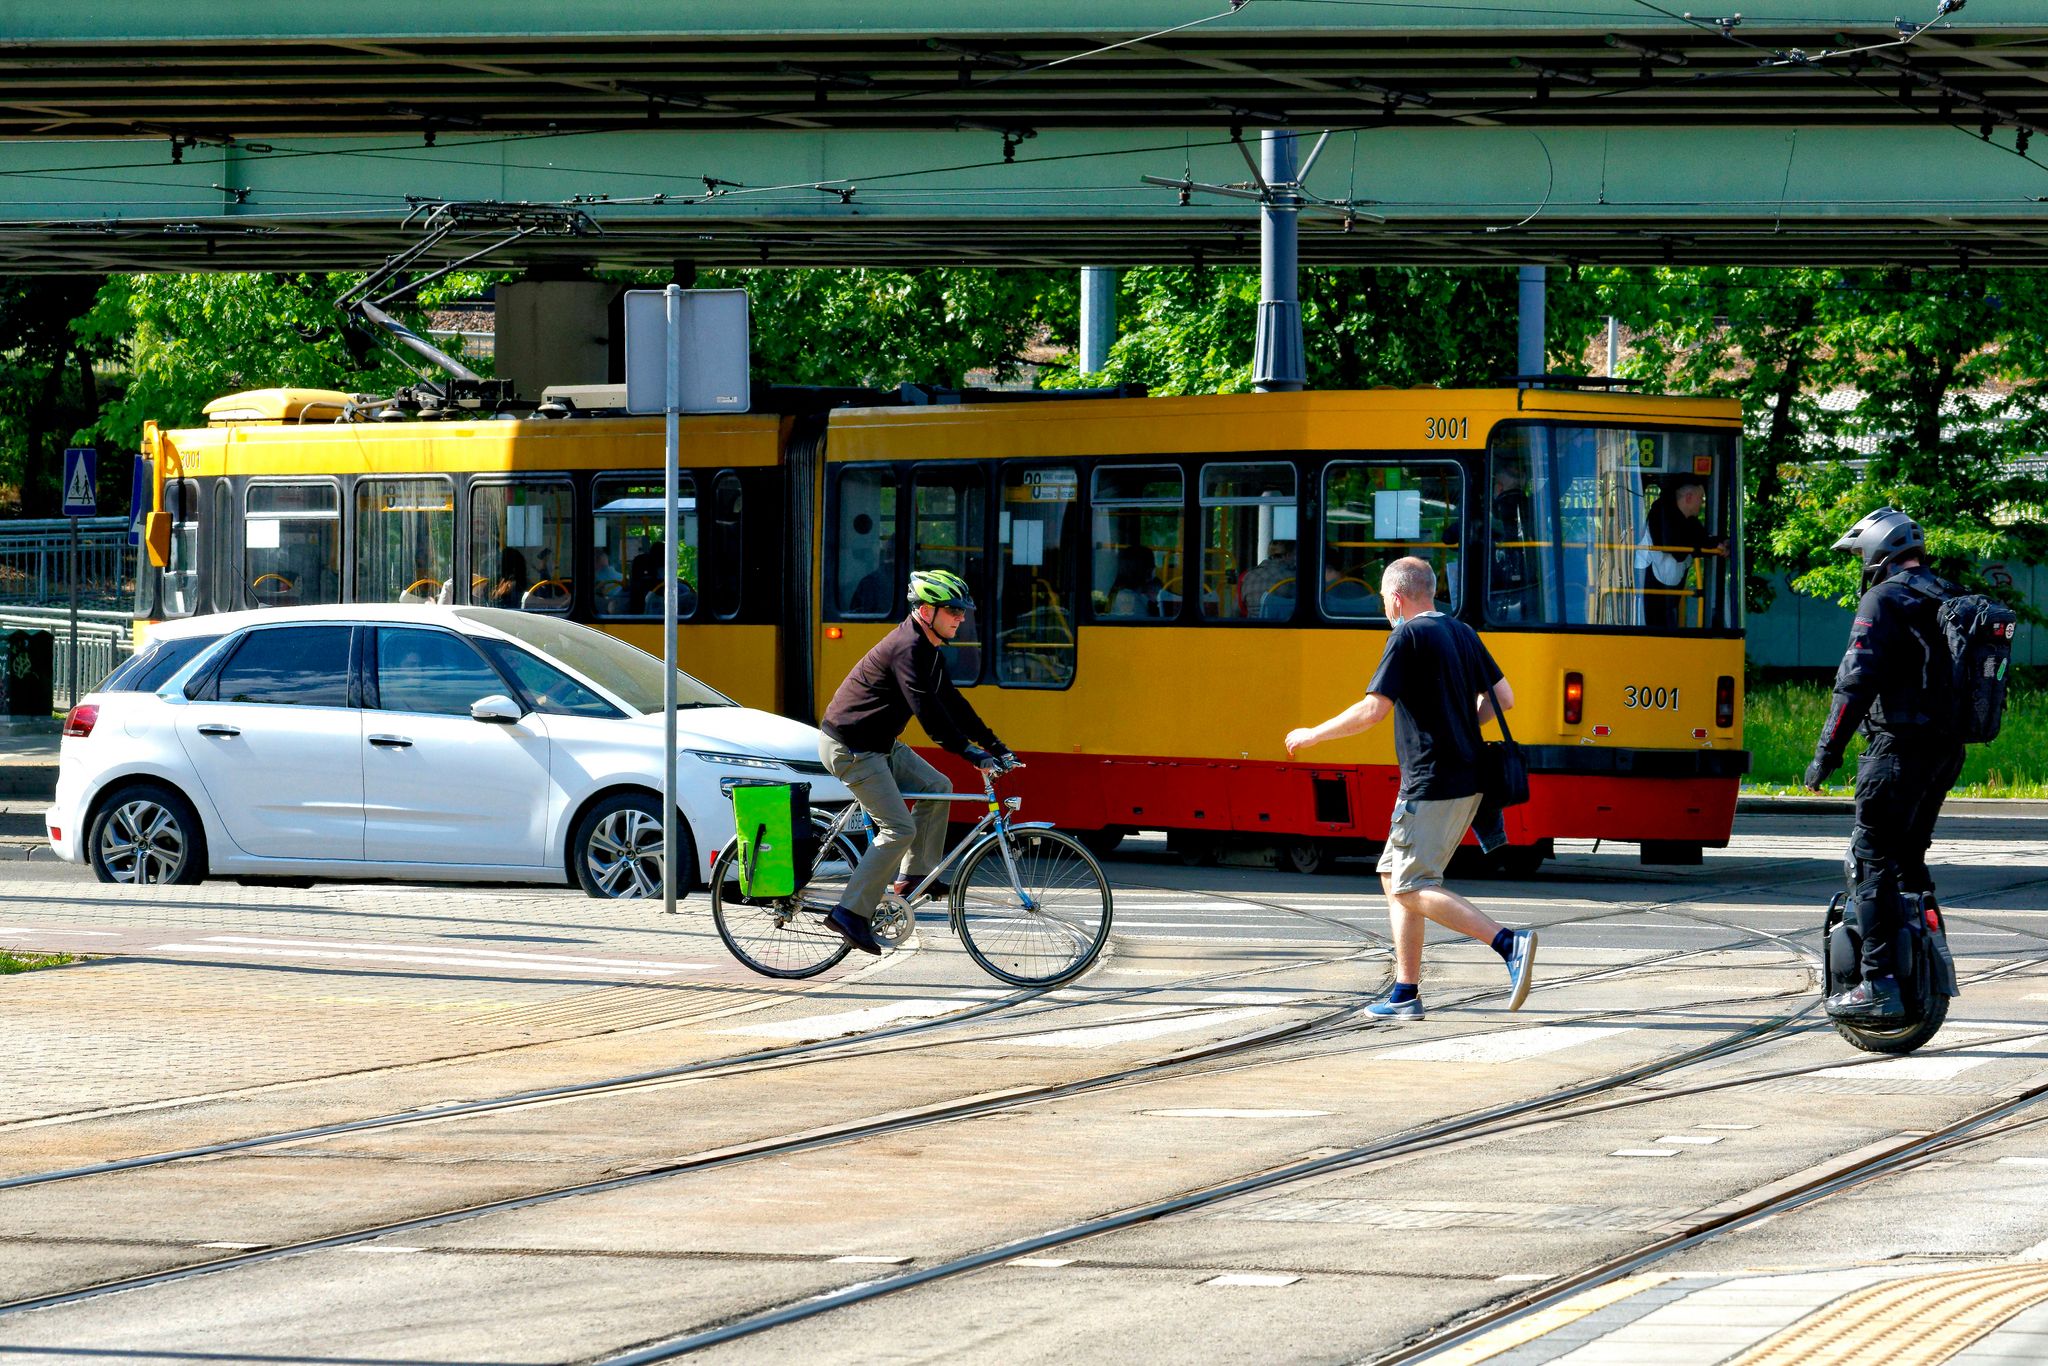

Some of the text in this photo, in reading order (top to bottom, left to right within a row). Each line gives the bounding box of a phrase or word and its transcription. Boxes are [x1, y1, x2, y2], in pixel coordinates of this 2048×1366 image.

[1425, 416, 1468, 440] 3001
[1623, 438, 1654, 467] 28
[1624, 685, 1679, 711] 3001
